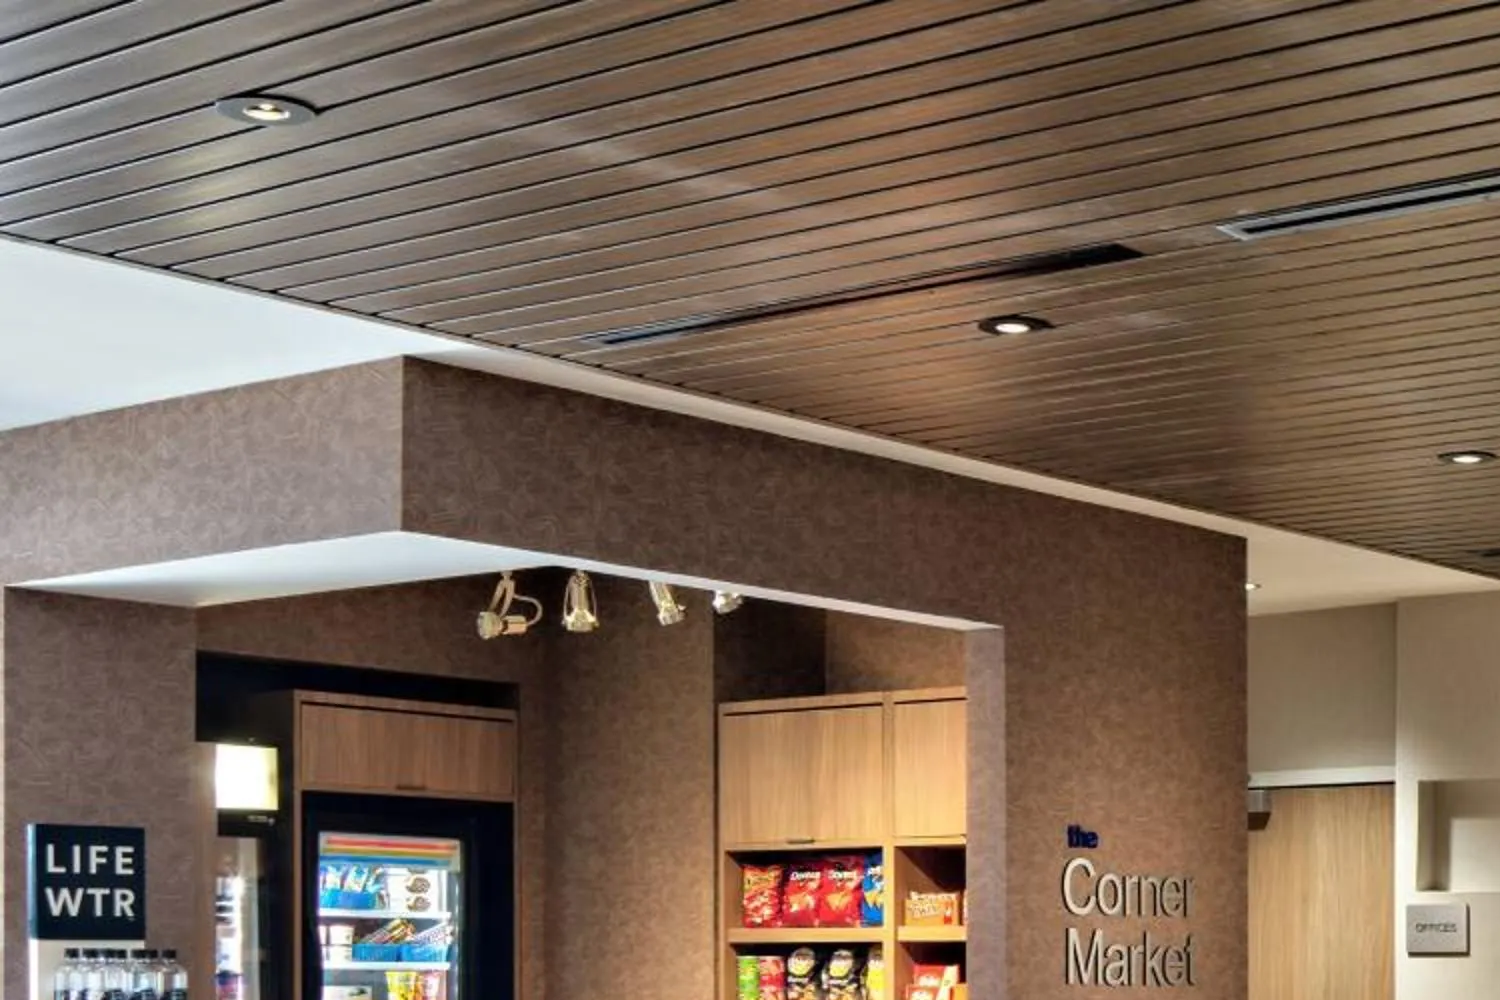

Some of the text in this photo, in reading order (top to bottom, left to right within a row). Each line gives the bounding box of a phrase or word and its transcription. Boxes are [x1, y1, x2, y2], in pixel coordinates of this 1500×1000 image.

[1067, 825, 1098, 848] the
[47, 844, 134, 875] LIFE
[45, 887, 135, 917] WTR
[1063, 857, 1196, 917] Corner
[1066, 927, 1196, 987] Market
